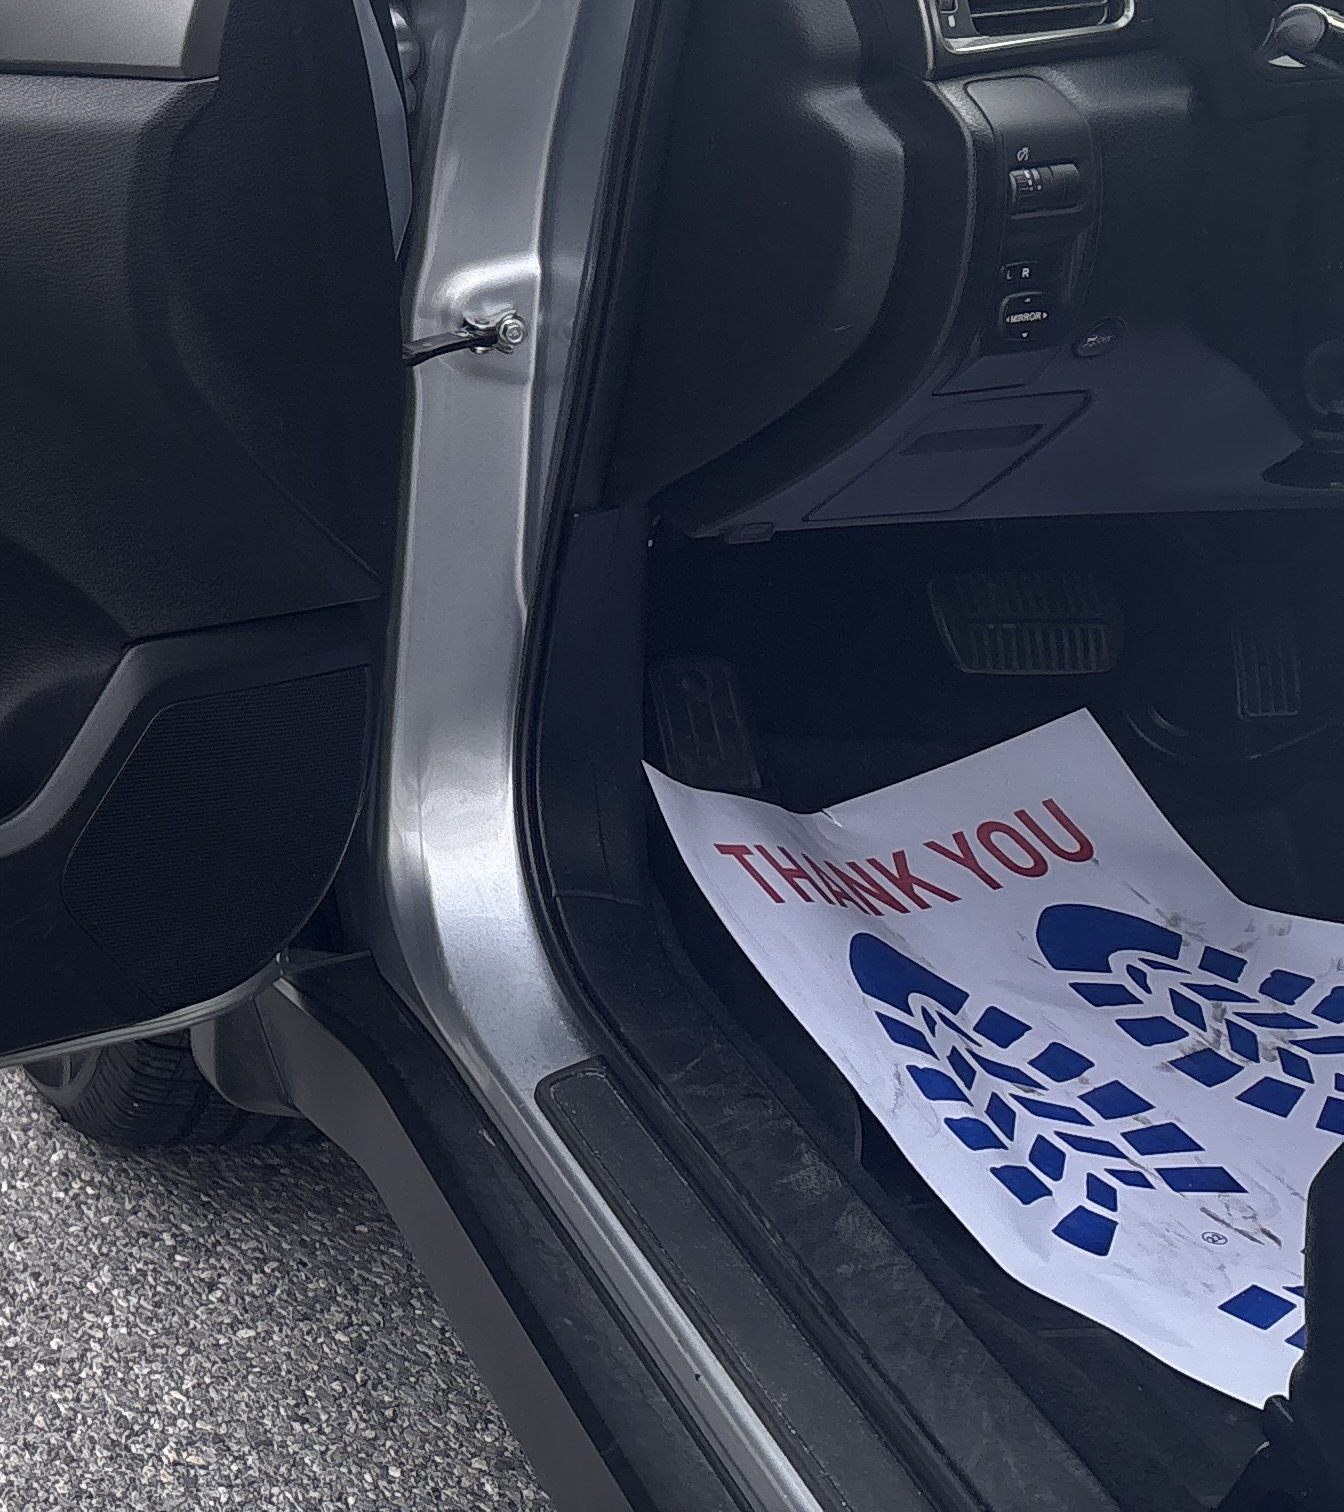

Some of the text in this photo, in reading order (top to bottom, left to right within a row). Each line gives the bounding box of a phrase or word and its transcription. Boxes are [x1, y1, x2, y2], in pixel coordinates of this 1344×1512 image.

[1021, 267, 1030, 278] R
[1010, 311, 1042, 323] MIRROR
[713, 798, 1095, 916] THANK YOU
